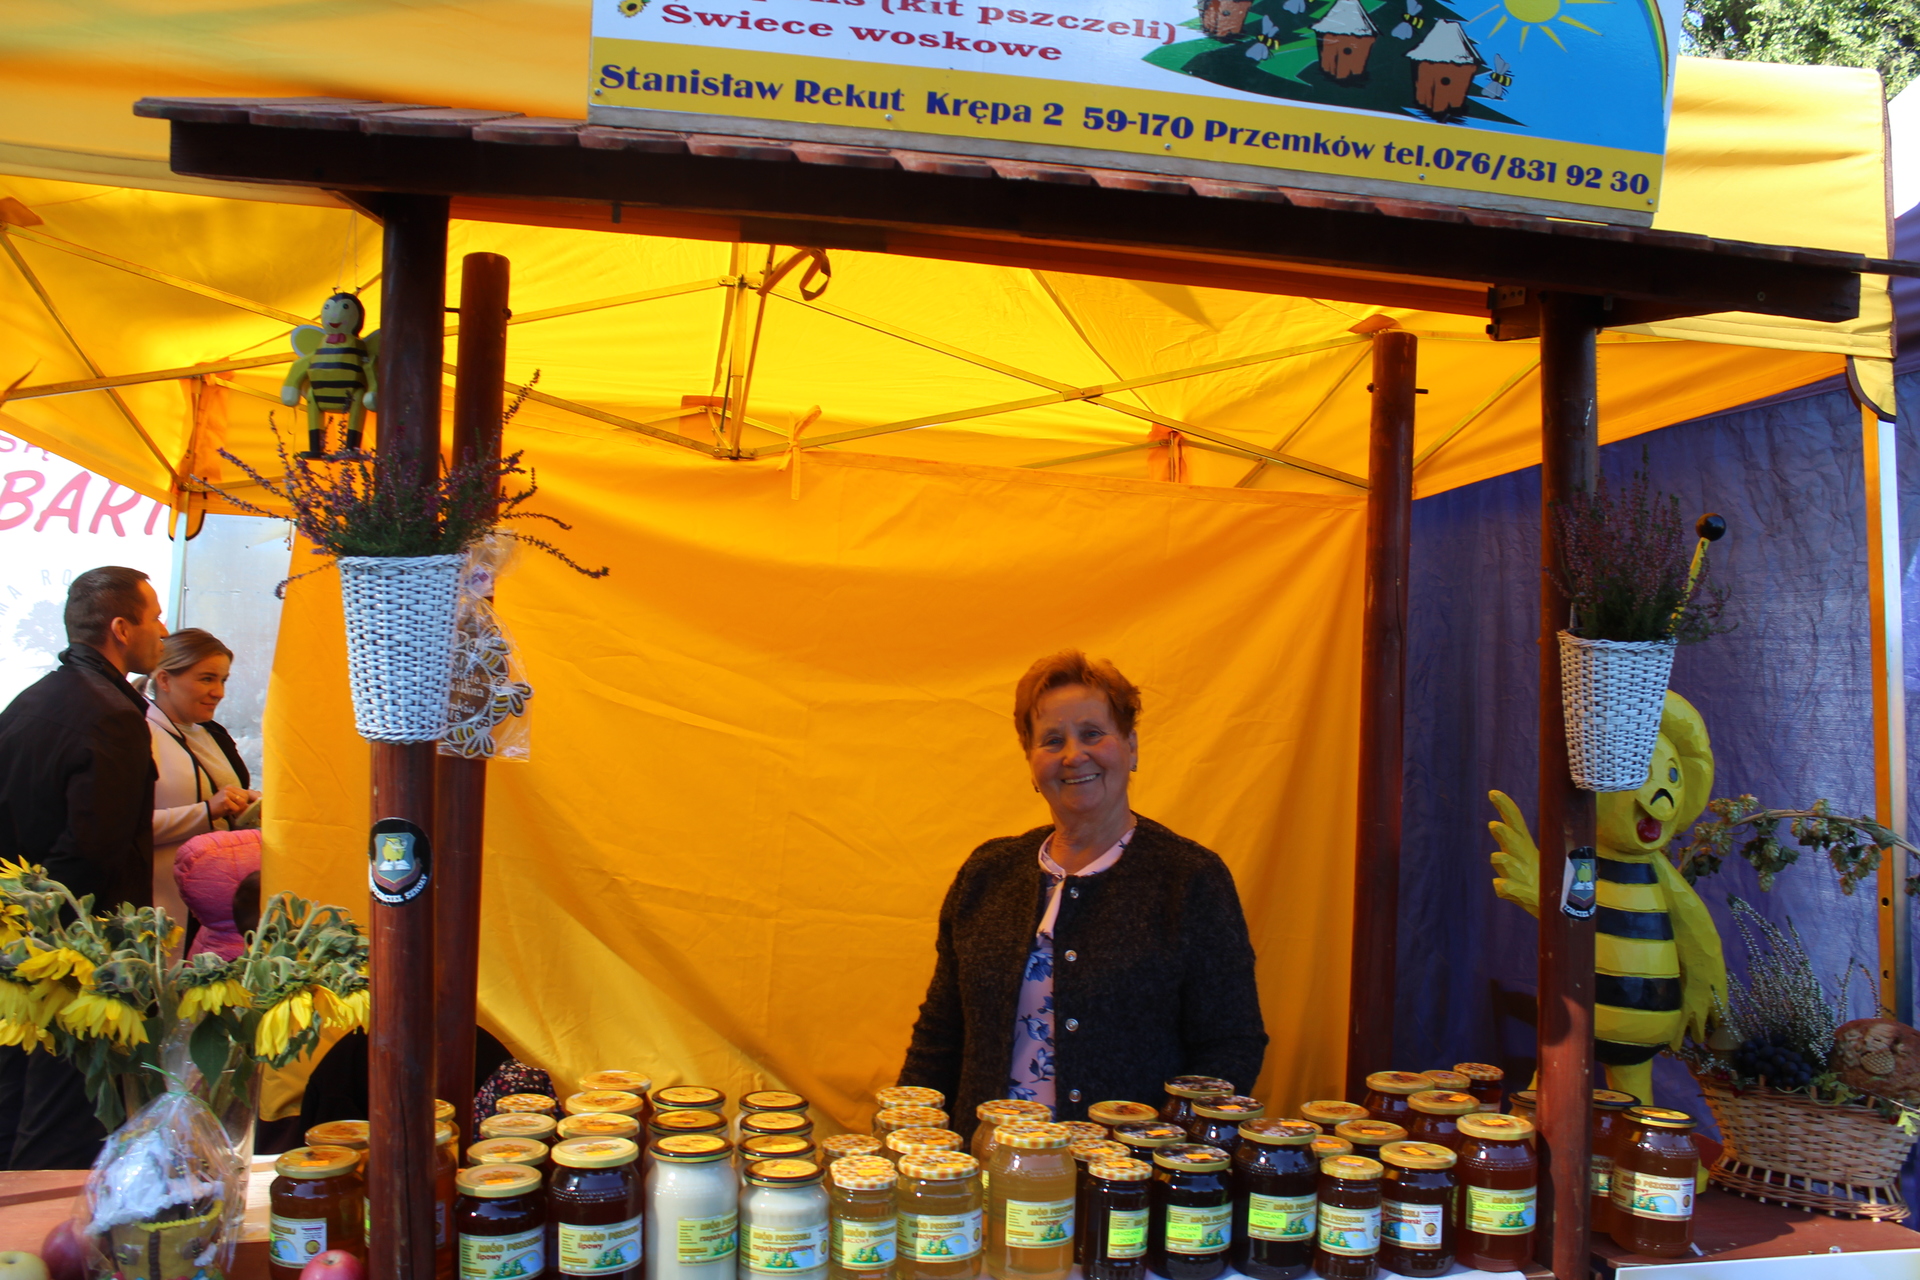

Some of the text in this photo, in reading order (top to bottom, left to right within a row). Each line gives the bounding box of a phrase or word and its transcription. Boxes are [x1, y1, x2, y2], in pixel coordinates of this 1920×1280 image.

[848, 26, 1062, 61] woskowe
[977, 7, 1177, 45] pszczeli)
[599, 64, 783, 101] Stanisław
[794, 79, 906, 112] Rekut
[926, 91, 1032, 126] Krępa
[1043, 102, 1064, 126] 2
[1083, 106, 1194, 139] 59-170
[1204, 119, 1376, 160] Przemków
[1566, 164, 1603, 189] 92
[1610, 170, 1650, 195] 30
